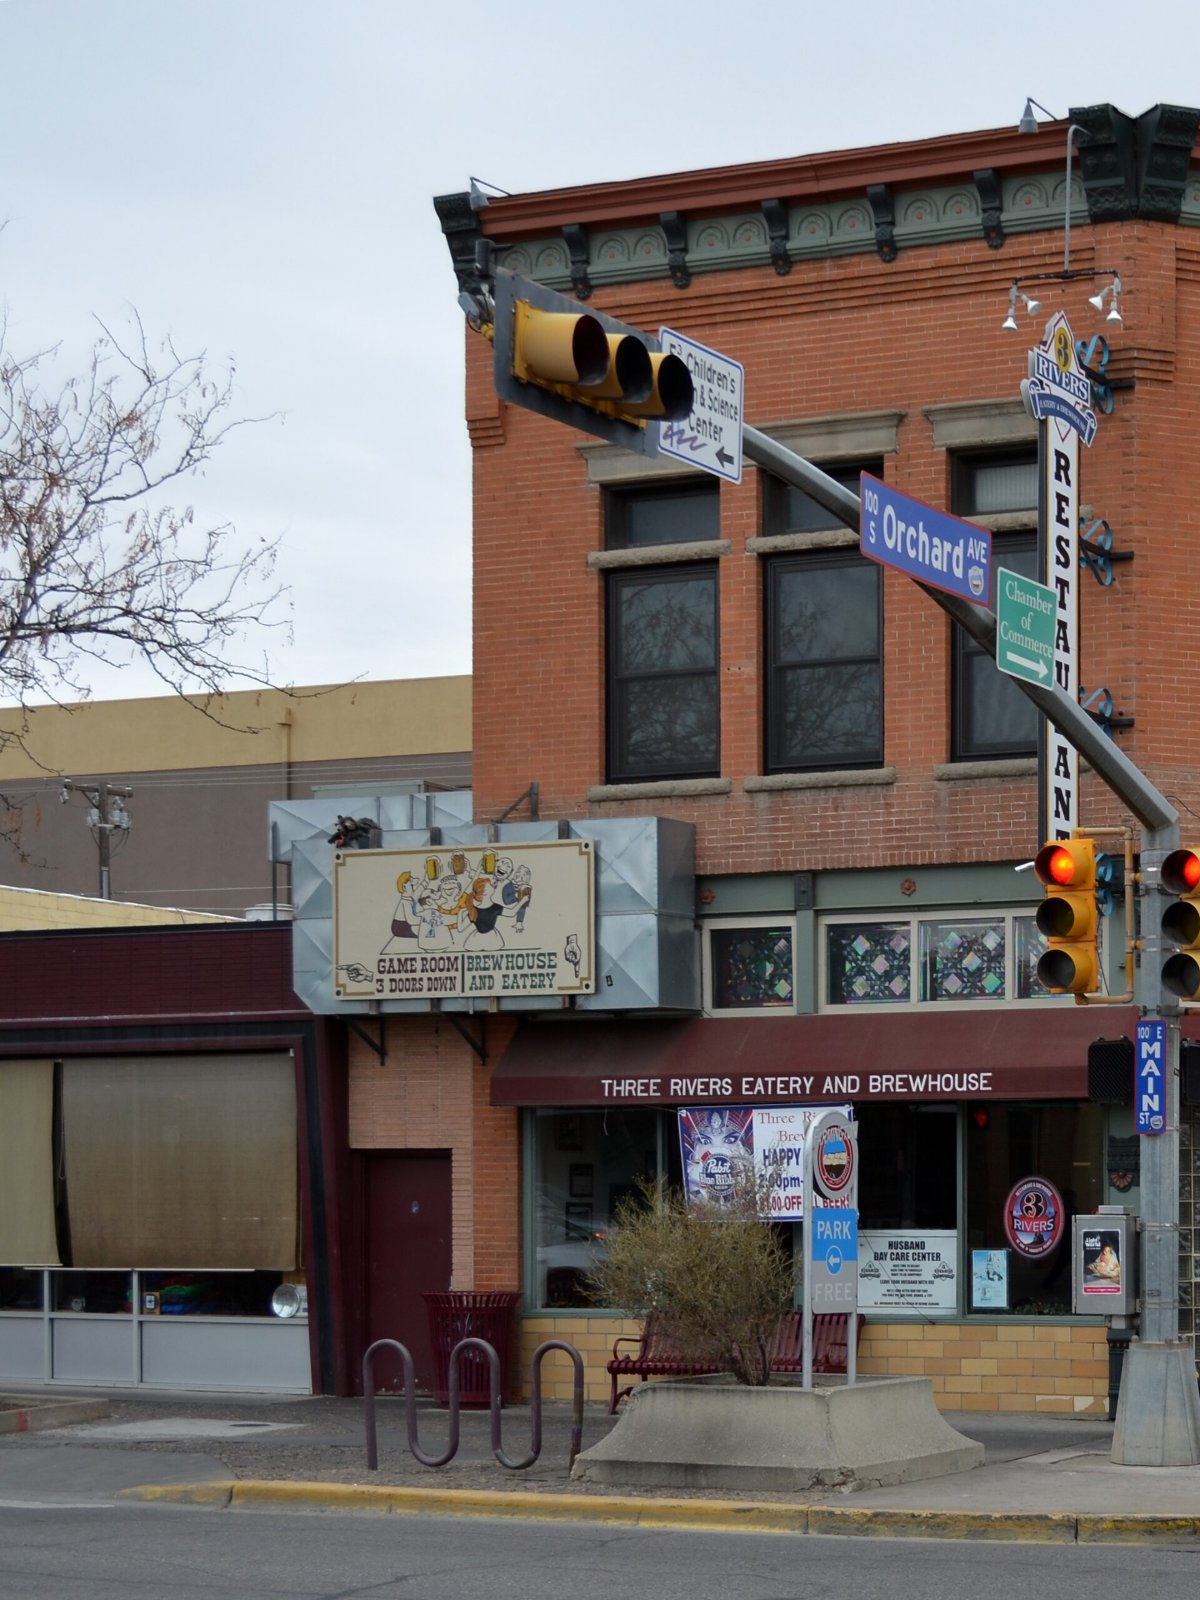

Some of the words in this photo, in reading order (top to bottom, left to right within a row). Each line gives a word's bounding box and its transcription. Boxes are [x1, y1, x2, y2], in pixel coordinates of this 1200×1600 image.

[1057, 332, 1069, 368] 3
[686, 352, 736, 395] Children's
[1038, 355, 1088, 401] RIVERS
[700, 385, 708, 409] &
[708, 389, 739, 423] Science
[688, 409, 723, 444] Center
[865, 488, 879, 517] 100
[869, 521, 876, 544] S
[883, 504, 964, 579] Orchard
[967, 537, 987, 564] AVE
[1005, 579, 1053, 616] Chamber
[1021, 612, 1034, 631] of
[1000, 622, 1053, 659] Commerce
[377, 957, 417, 975] GAME
[420, 956, 459, 973] ROOM
[375, 979, 385, 993] 3
[389, 977, 424, 993] DOORS
[427, 976, 457, 992] DOWN
[468, 973, 495, 991] AND
[502, 972, 557, 990] EATERY
[1138, 1026, 1150, 1039] 100
[1157, 1026, 1162, 1039] E
[601, 1079, 661, 1097] THREE
[670, 1077, 732, 1096] RIVERS
[741, 1076, 814, 1095] EATERY
[822, 1075, 860, 1094] AND
[868, 1072, 993, 1093] BREWHOUSE
[1140, 1041, 1161, 1112] MAIN
[757, 1112, 795, 1125] Three
[1139, 1112, 1150, 1125] ST
[763, 1147, 801, 1166] HAPPY
[705, 1159, 731, 1174] Pabst
[784, 1195, 802, 1211] OFF
[1022, 1191, 1045, 1218] 3
[817, 1220, 852, 1240] PARK
[1013, 1218, 1054, 1232] RIVERS
[888, 1240, 926, 1250] HUSBAND
[889, 1251, 910, 1261] CARE
[911, 1251, 941, 1262] CENTER
[814, 1283, 853, 1302] FREE
